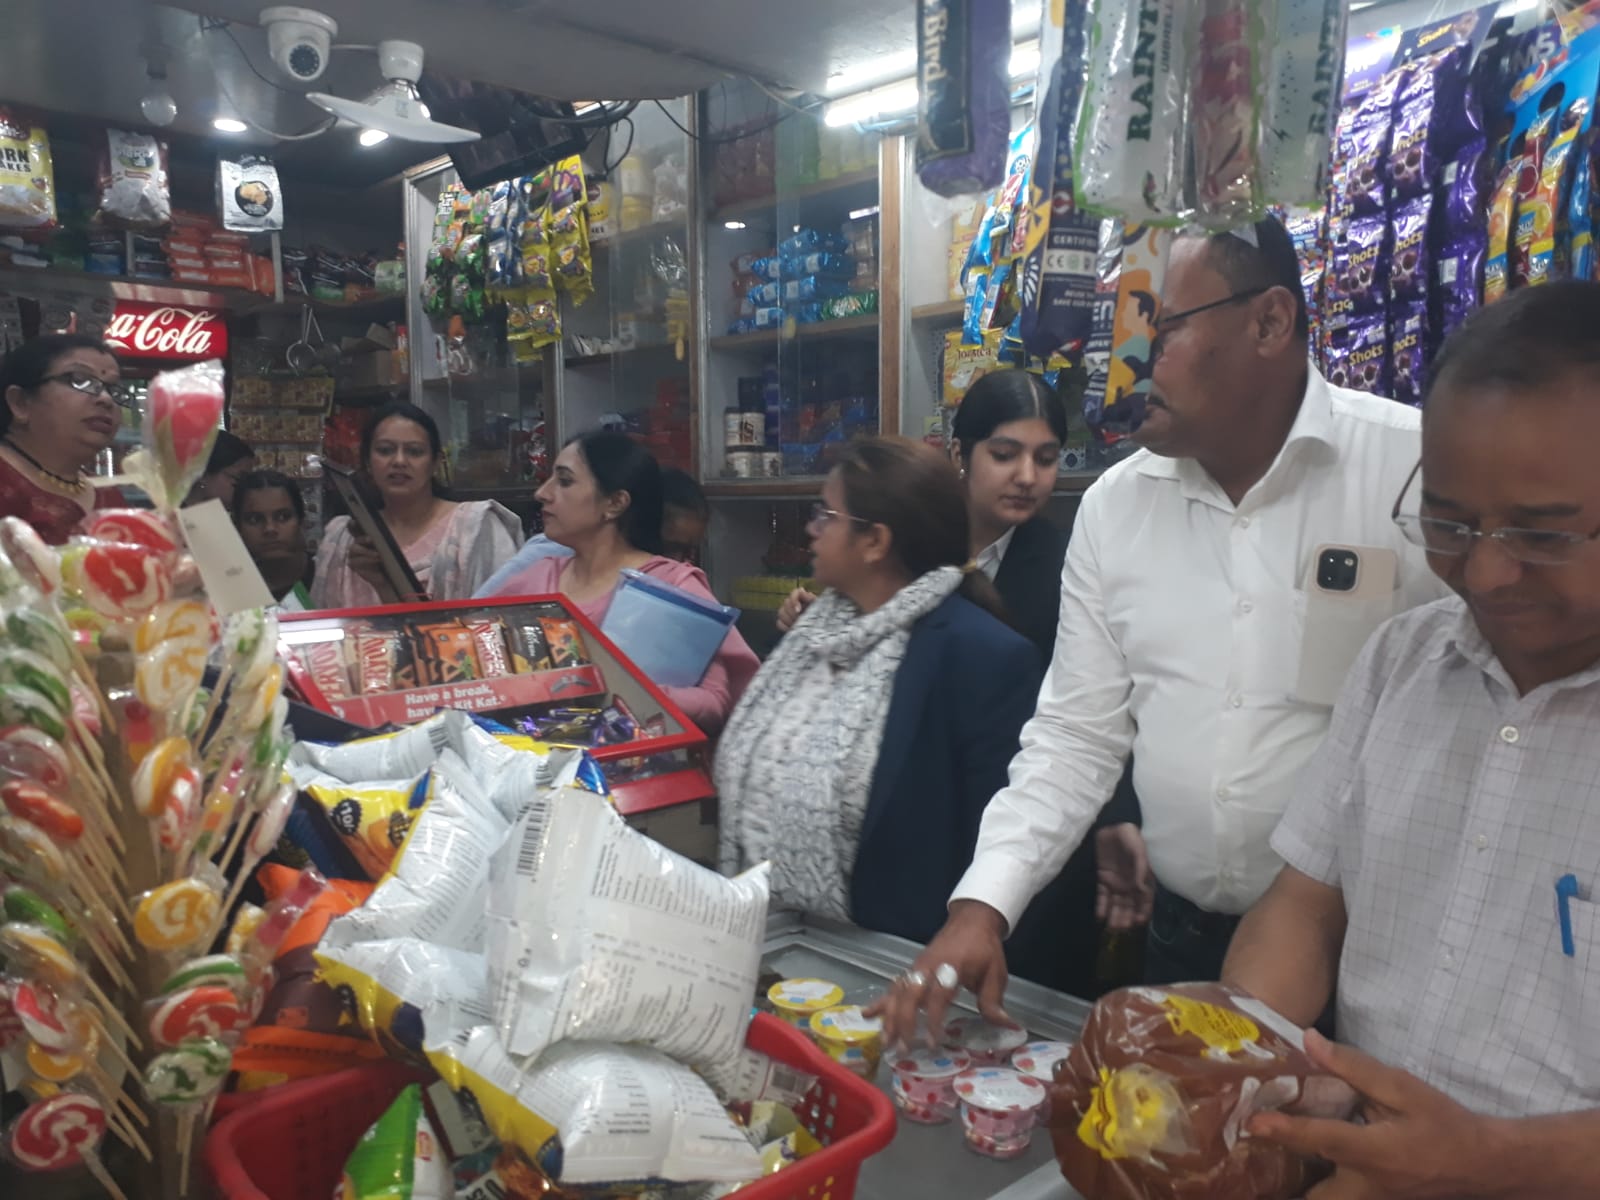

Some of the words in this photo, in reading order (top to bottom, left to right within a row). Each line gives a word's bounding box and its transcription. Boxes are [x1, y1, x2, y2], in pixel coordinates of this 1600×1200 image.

[1125, 0, 1158, 141] RAINT
[0, 147, 30, 163] RN
[1348, 245, 1379, 268] Shots
[1350, 344, 1383, 367] Shots
[405, 693, 439, 705] Have
[443, 690, 451, 699] a
[407, 707, 436, 719] hav
